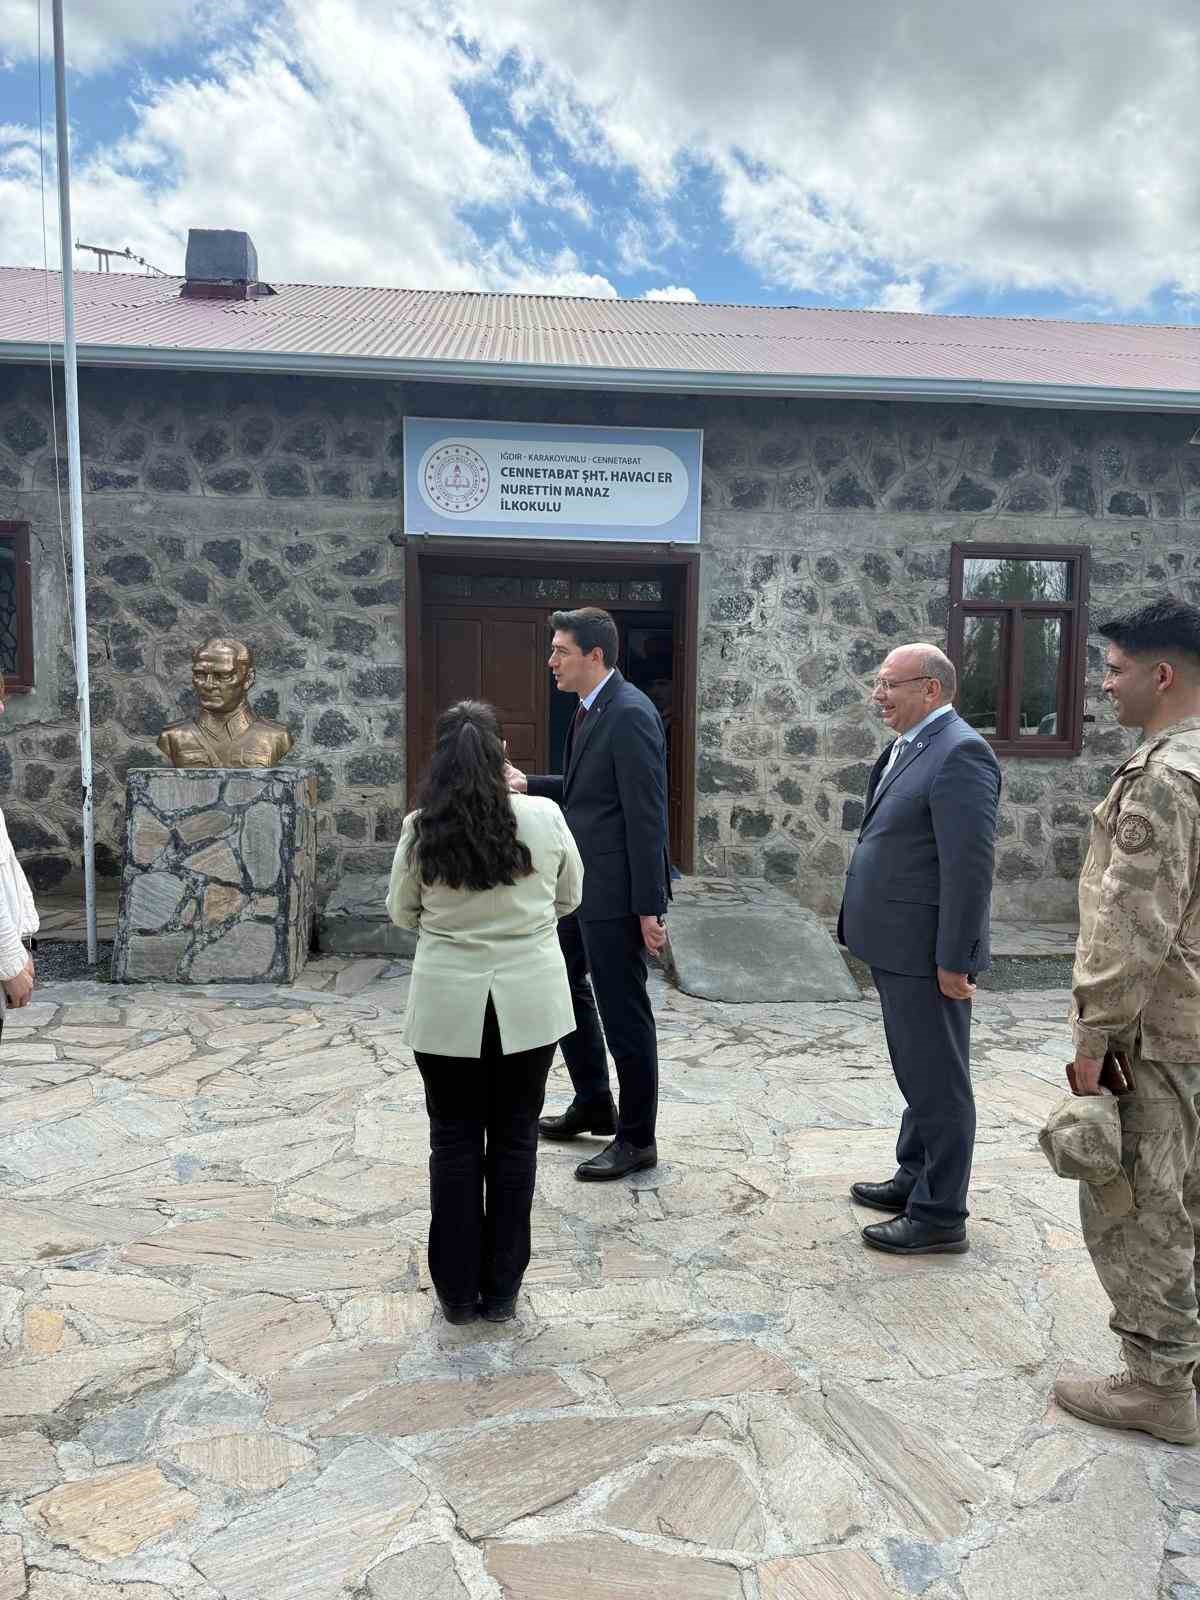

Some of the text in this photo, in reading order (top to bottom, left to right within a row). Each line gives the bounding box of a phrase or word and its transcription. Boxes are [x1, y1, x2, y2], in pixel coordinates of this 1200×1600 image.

[529, 454, 587, 463] KARAKOYUNLU
[501, 467, 672, 483] CENNETABAT ŞHT. HAVACI ER
[501, 484, 610, 497] NURETTİN MANAZ
[501, 498, 561, 512] İLKOKULU
